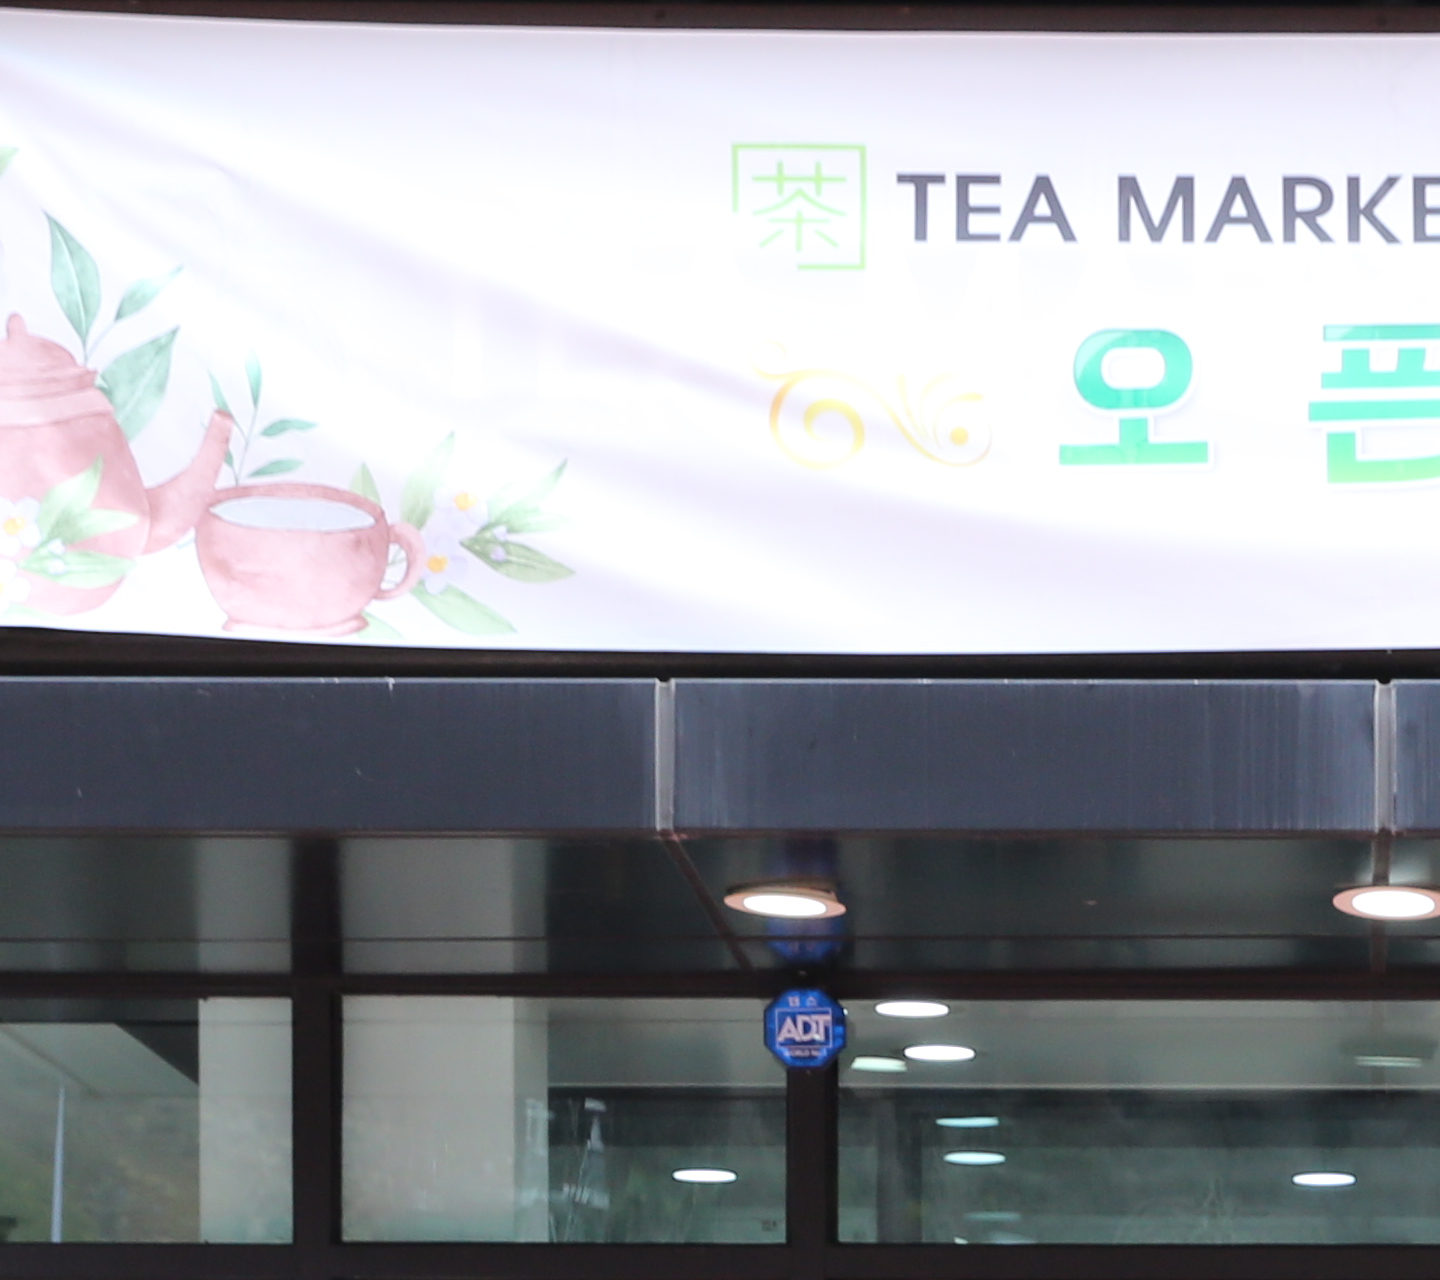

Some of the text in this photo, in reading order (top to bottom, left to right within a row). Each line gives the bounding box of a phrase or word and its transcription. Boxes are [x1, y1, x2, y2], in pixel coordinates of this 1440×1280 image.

[752, 160, 847, 252] 茶
[896, 171, 1078, 243] TEA
[777, 1014, 832, 1043] ADT
